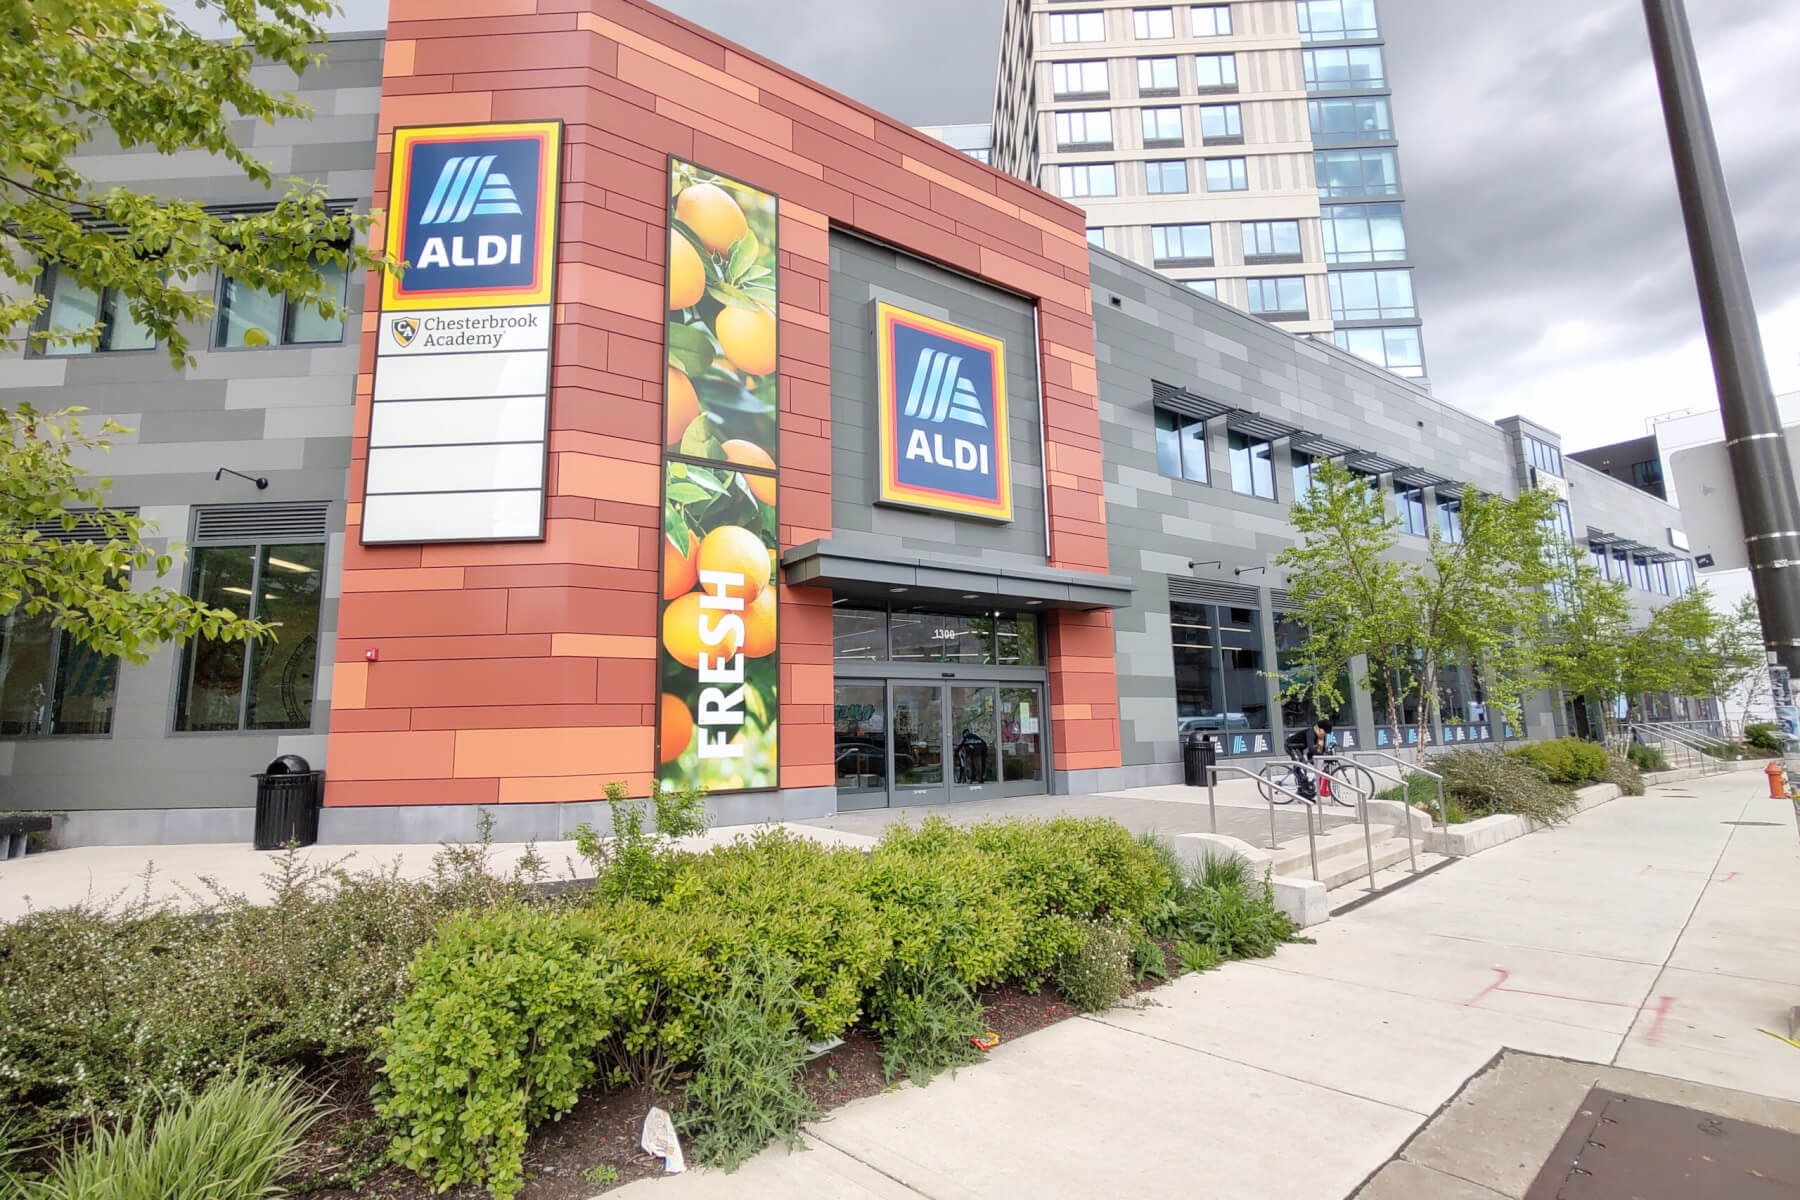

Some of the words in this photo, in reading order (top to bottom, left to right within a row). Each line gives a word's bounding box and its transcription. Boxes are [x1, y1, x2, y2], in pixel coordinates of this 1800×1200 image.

[417, 234, 522, 268] ALDI
[424, 313, 537, 331] Chesterbrook
[424, 332, 503, 348] Academy
[905, 429, 989, 475] ALDI
[934, 629, 955, 639] 1300
[698, 569, 745, 760] FRESH
